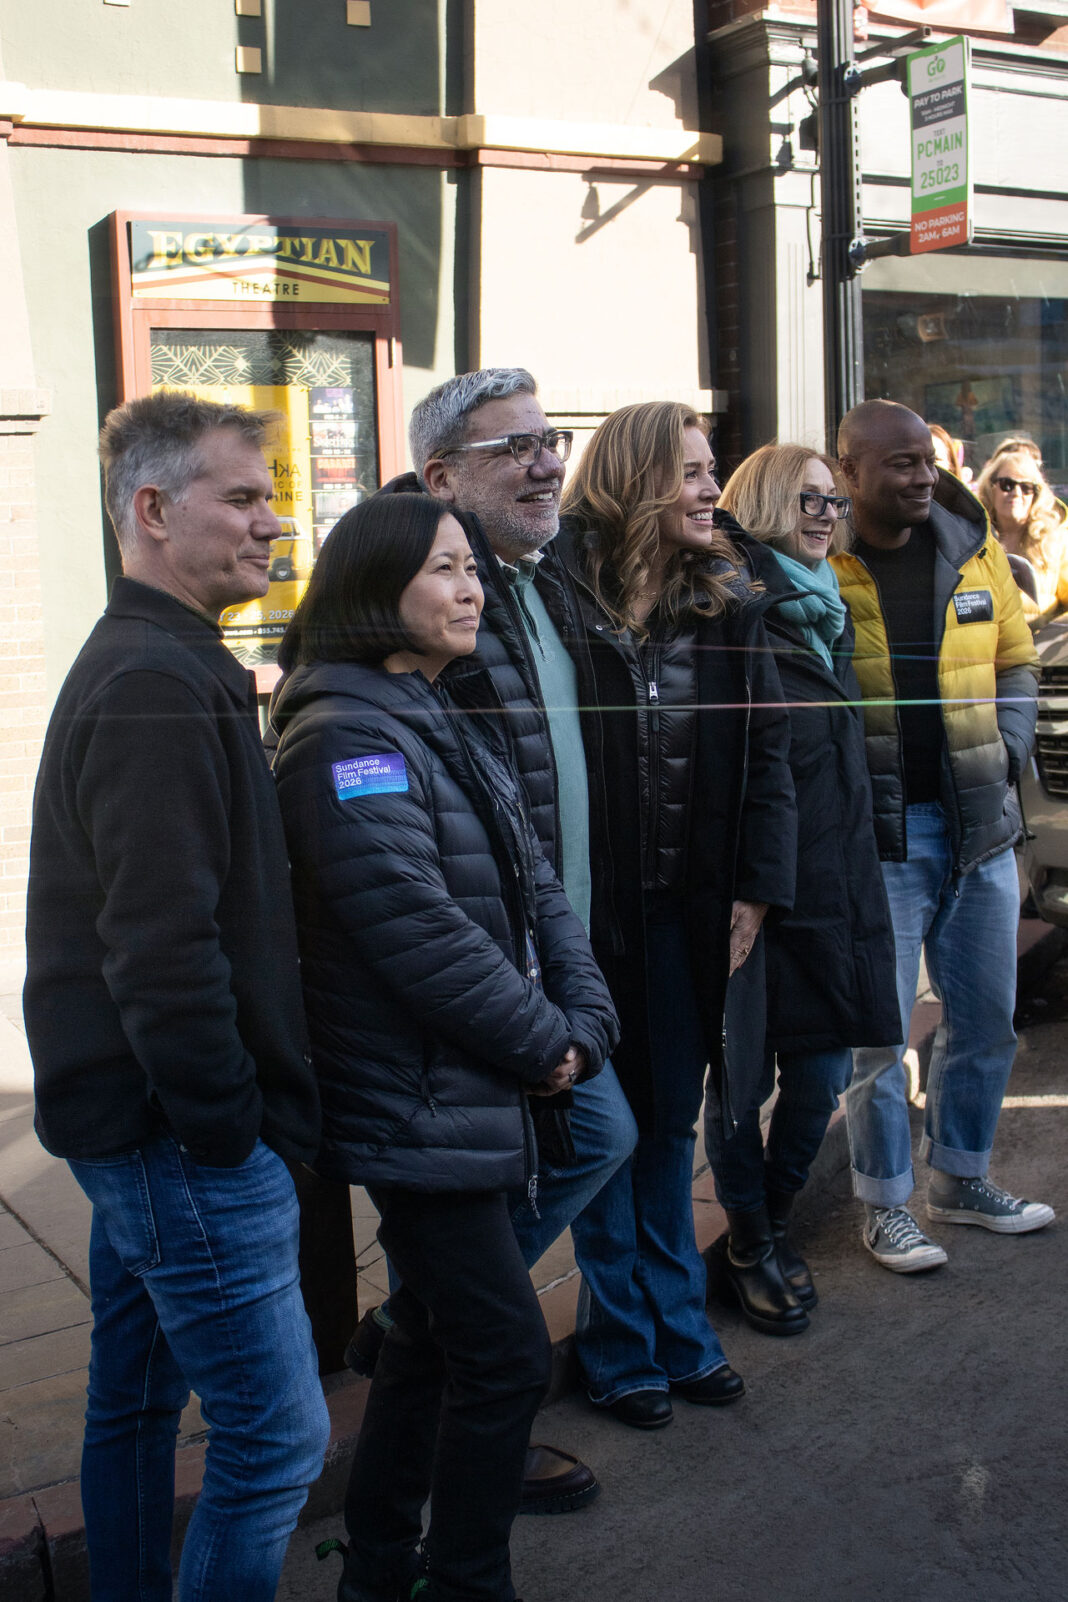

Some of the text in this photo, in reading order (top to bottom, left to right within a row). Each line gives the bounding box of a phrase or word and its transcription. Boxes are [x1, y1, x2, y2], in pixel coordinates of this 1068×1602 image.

[914, 85, 963, 109] PAY TO PARK
[917, 131, 963, 160] PCMAIN
[920, 163, 959, 189] 25023
[914, 211, 965, 232] NO PARKING
[919, 231, 937, 243] 2AM
[942, 225, 960, 237] 6AM
[146, 230, 376, 275] EGYPTIAN
[233, 282, 300, 296] THEATRE
[269, 609, 295, 619] 2026
[957, 607, 972, 615] 2026
[335, 759, 380, 773] Sundance
[337, 765, 391, 781] Film Festival
[339, 777, 362, 789] 2026
